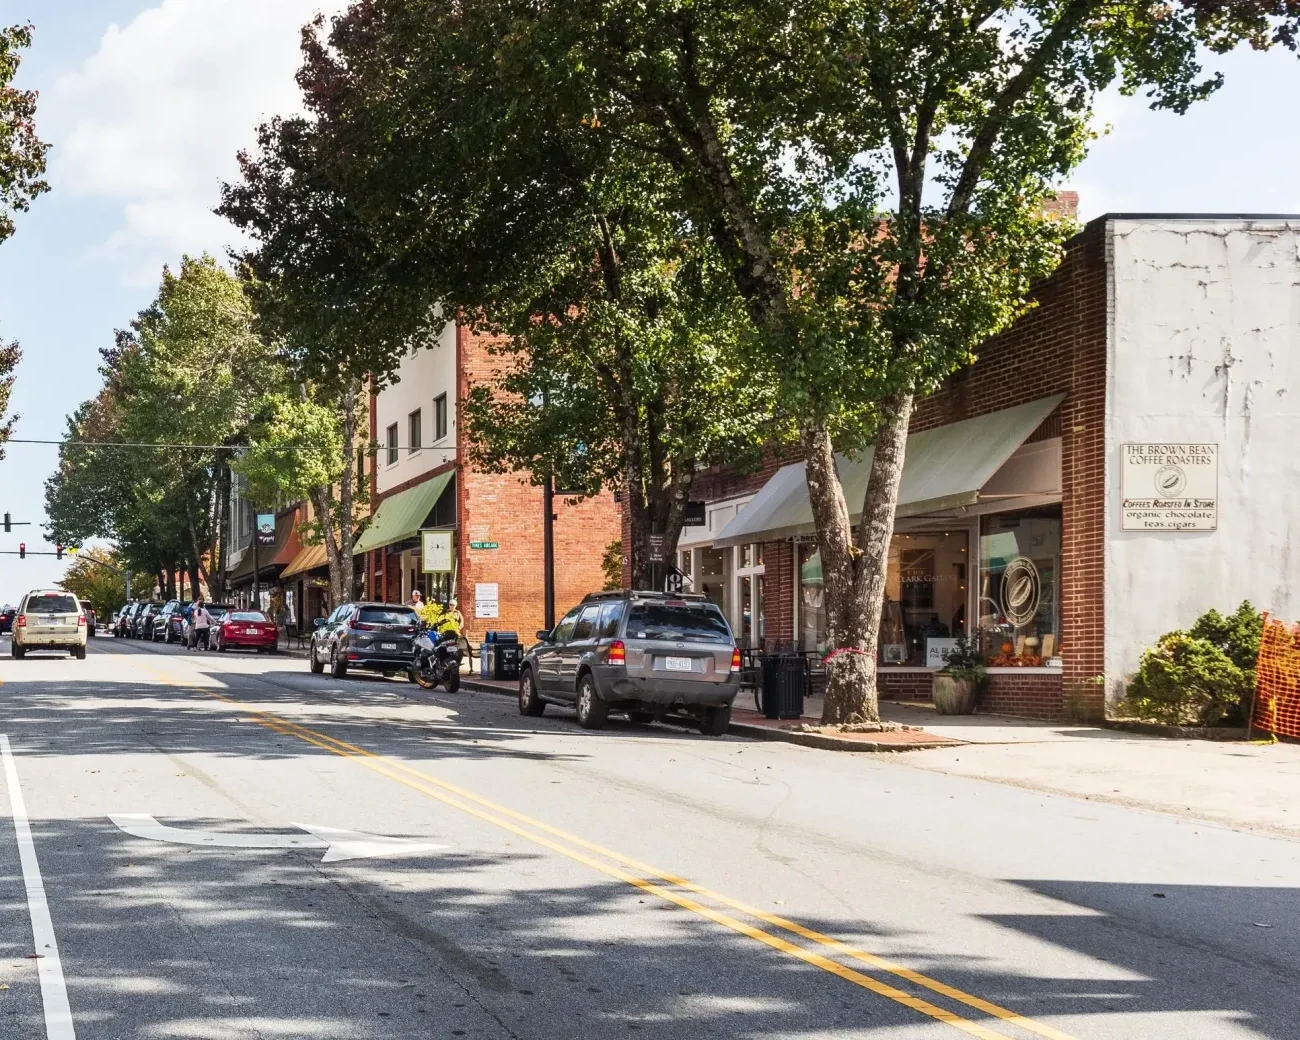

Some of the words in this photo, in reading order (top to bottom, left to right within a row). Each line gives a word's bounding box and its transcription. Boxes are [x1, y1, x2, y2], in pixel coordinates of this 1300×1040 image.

[1127, 445, 1144, 454] THE
[1148, 445, 1186, 454] BROWN
[1189, 445, 1214, 455] BEAN
[1129, 455, 1163, 465] COFFEE
[1166, 455, 1211, 465] ROASTERS
[1126, 511, 1161, 519] organic
